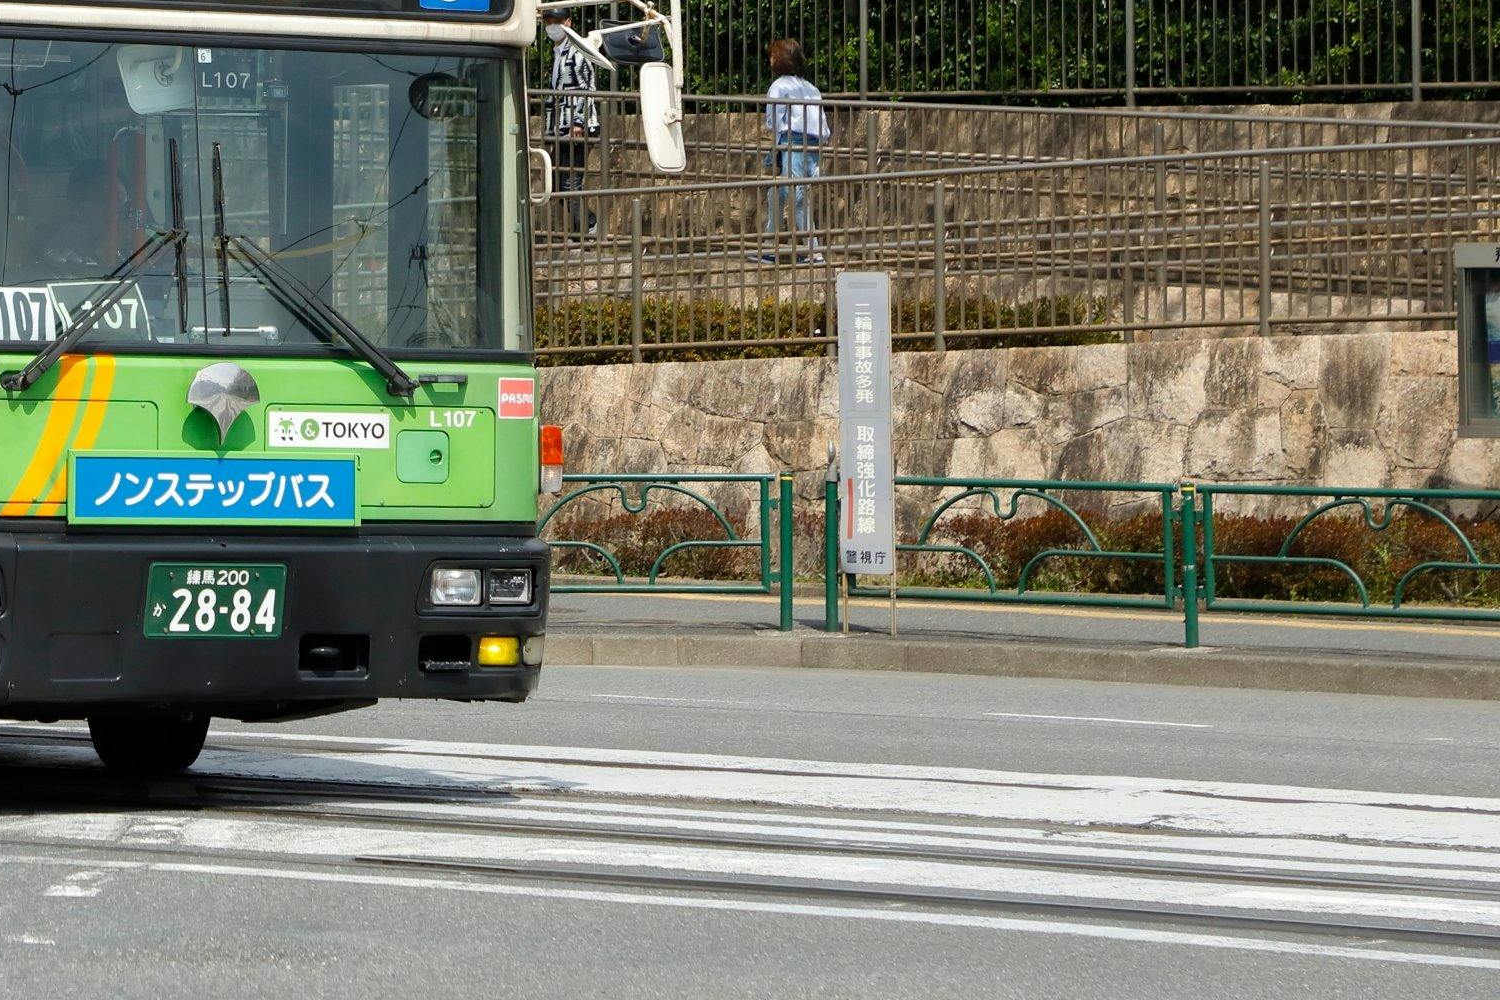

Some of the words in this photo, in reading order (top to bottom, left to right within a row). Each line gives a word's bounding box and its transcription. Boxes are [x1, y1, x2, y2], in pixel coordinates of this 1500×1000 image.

[202, 71, 251, 89] L107
[854, 302, 874, 404] 二輪車事故多発
[501, 392, 534, 405] PASM
[429, 409, 477, 428] L107
[321, 421, 385, 439] TOKYO
[856, 425, 876, 534] 取締強化路線
[95, 471, 336, 508] ノンステップバス
[846, 549, 887, 564] 警視庁
[152, 602, 167, 618] か
[168, 588, 276, 633] 28-84
